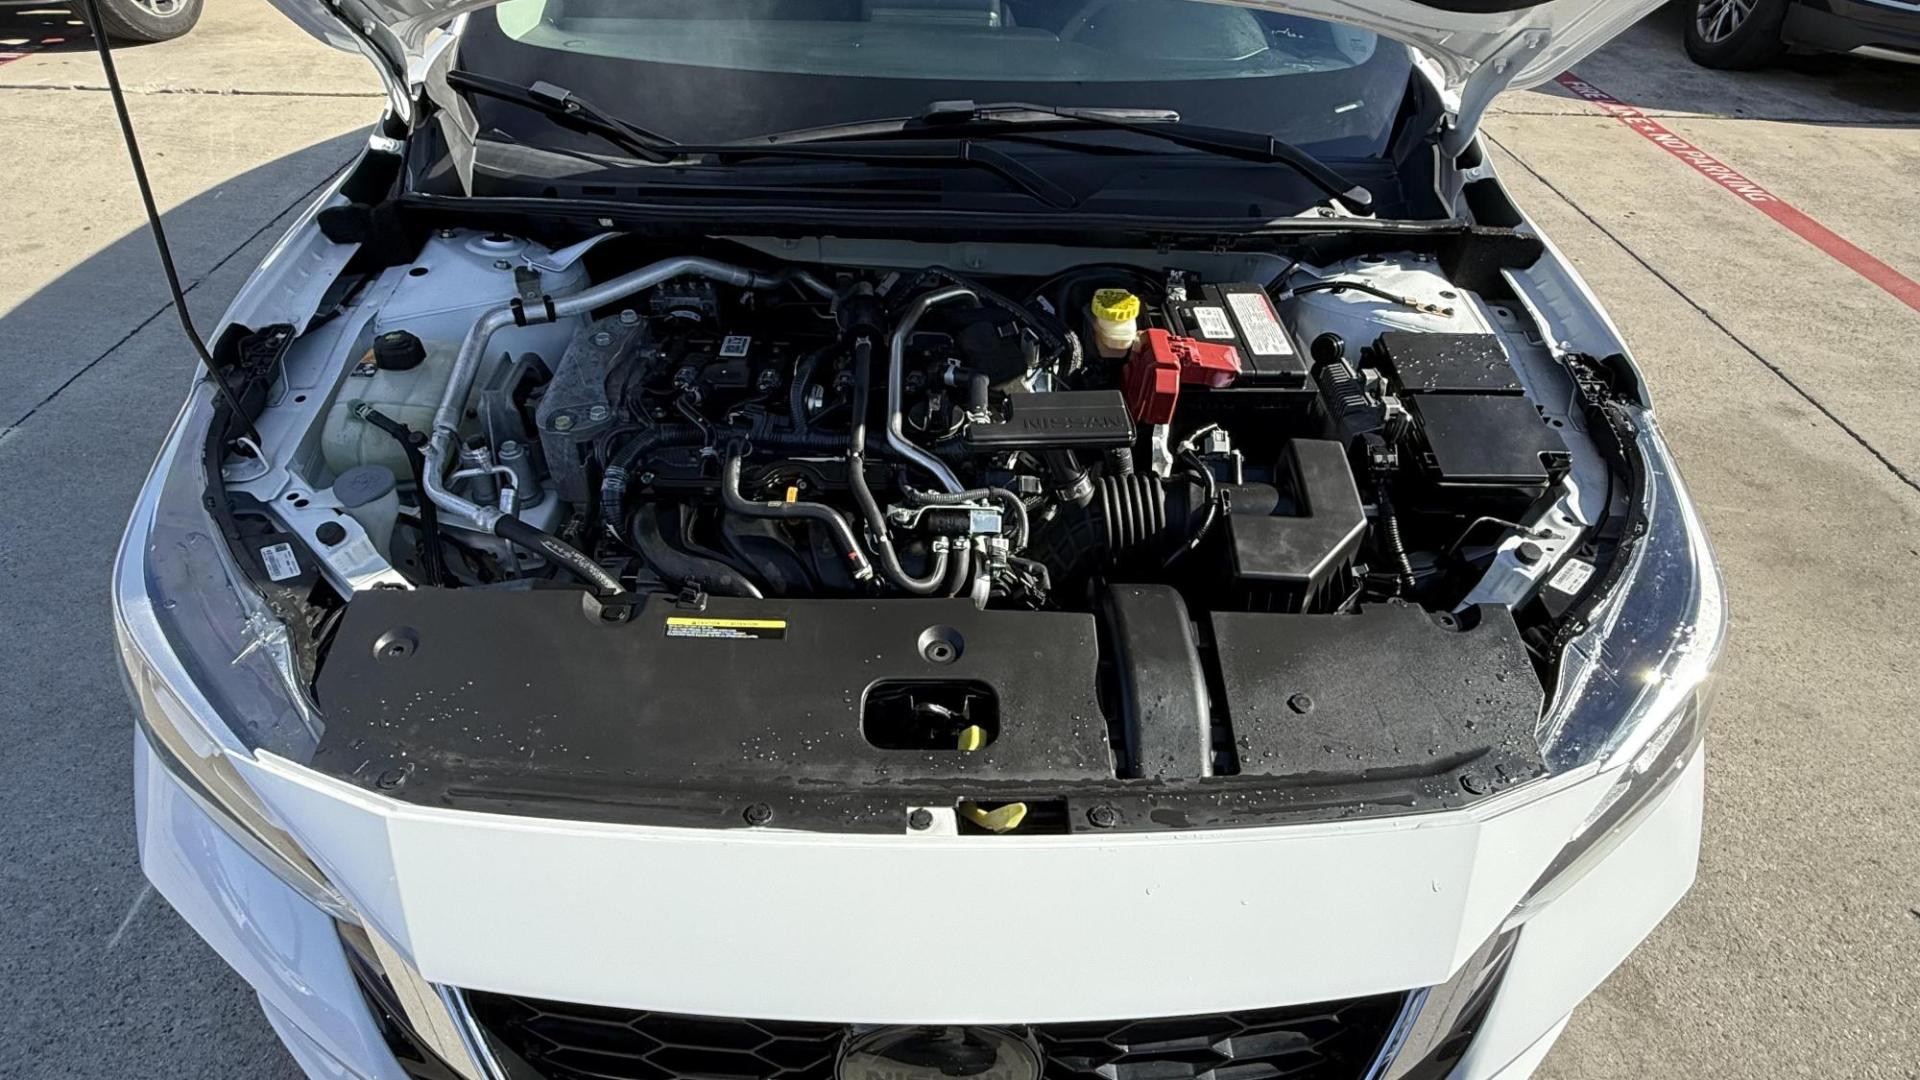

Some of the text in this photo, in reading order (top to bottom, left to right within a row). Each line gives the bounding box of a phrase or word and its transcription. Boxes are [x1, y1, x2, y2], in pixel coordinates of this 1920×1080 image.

[1563, 81, 1609, 99] FIRE
[1650, 132, 1690, 150] NO
[1686, 149, 1779, 202] PARKING
[1023, 414, 1123, 430] NISSAN
